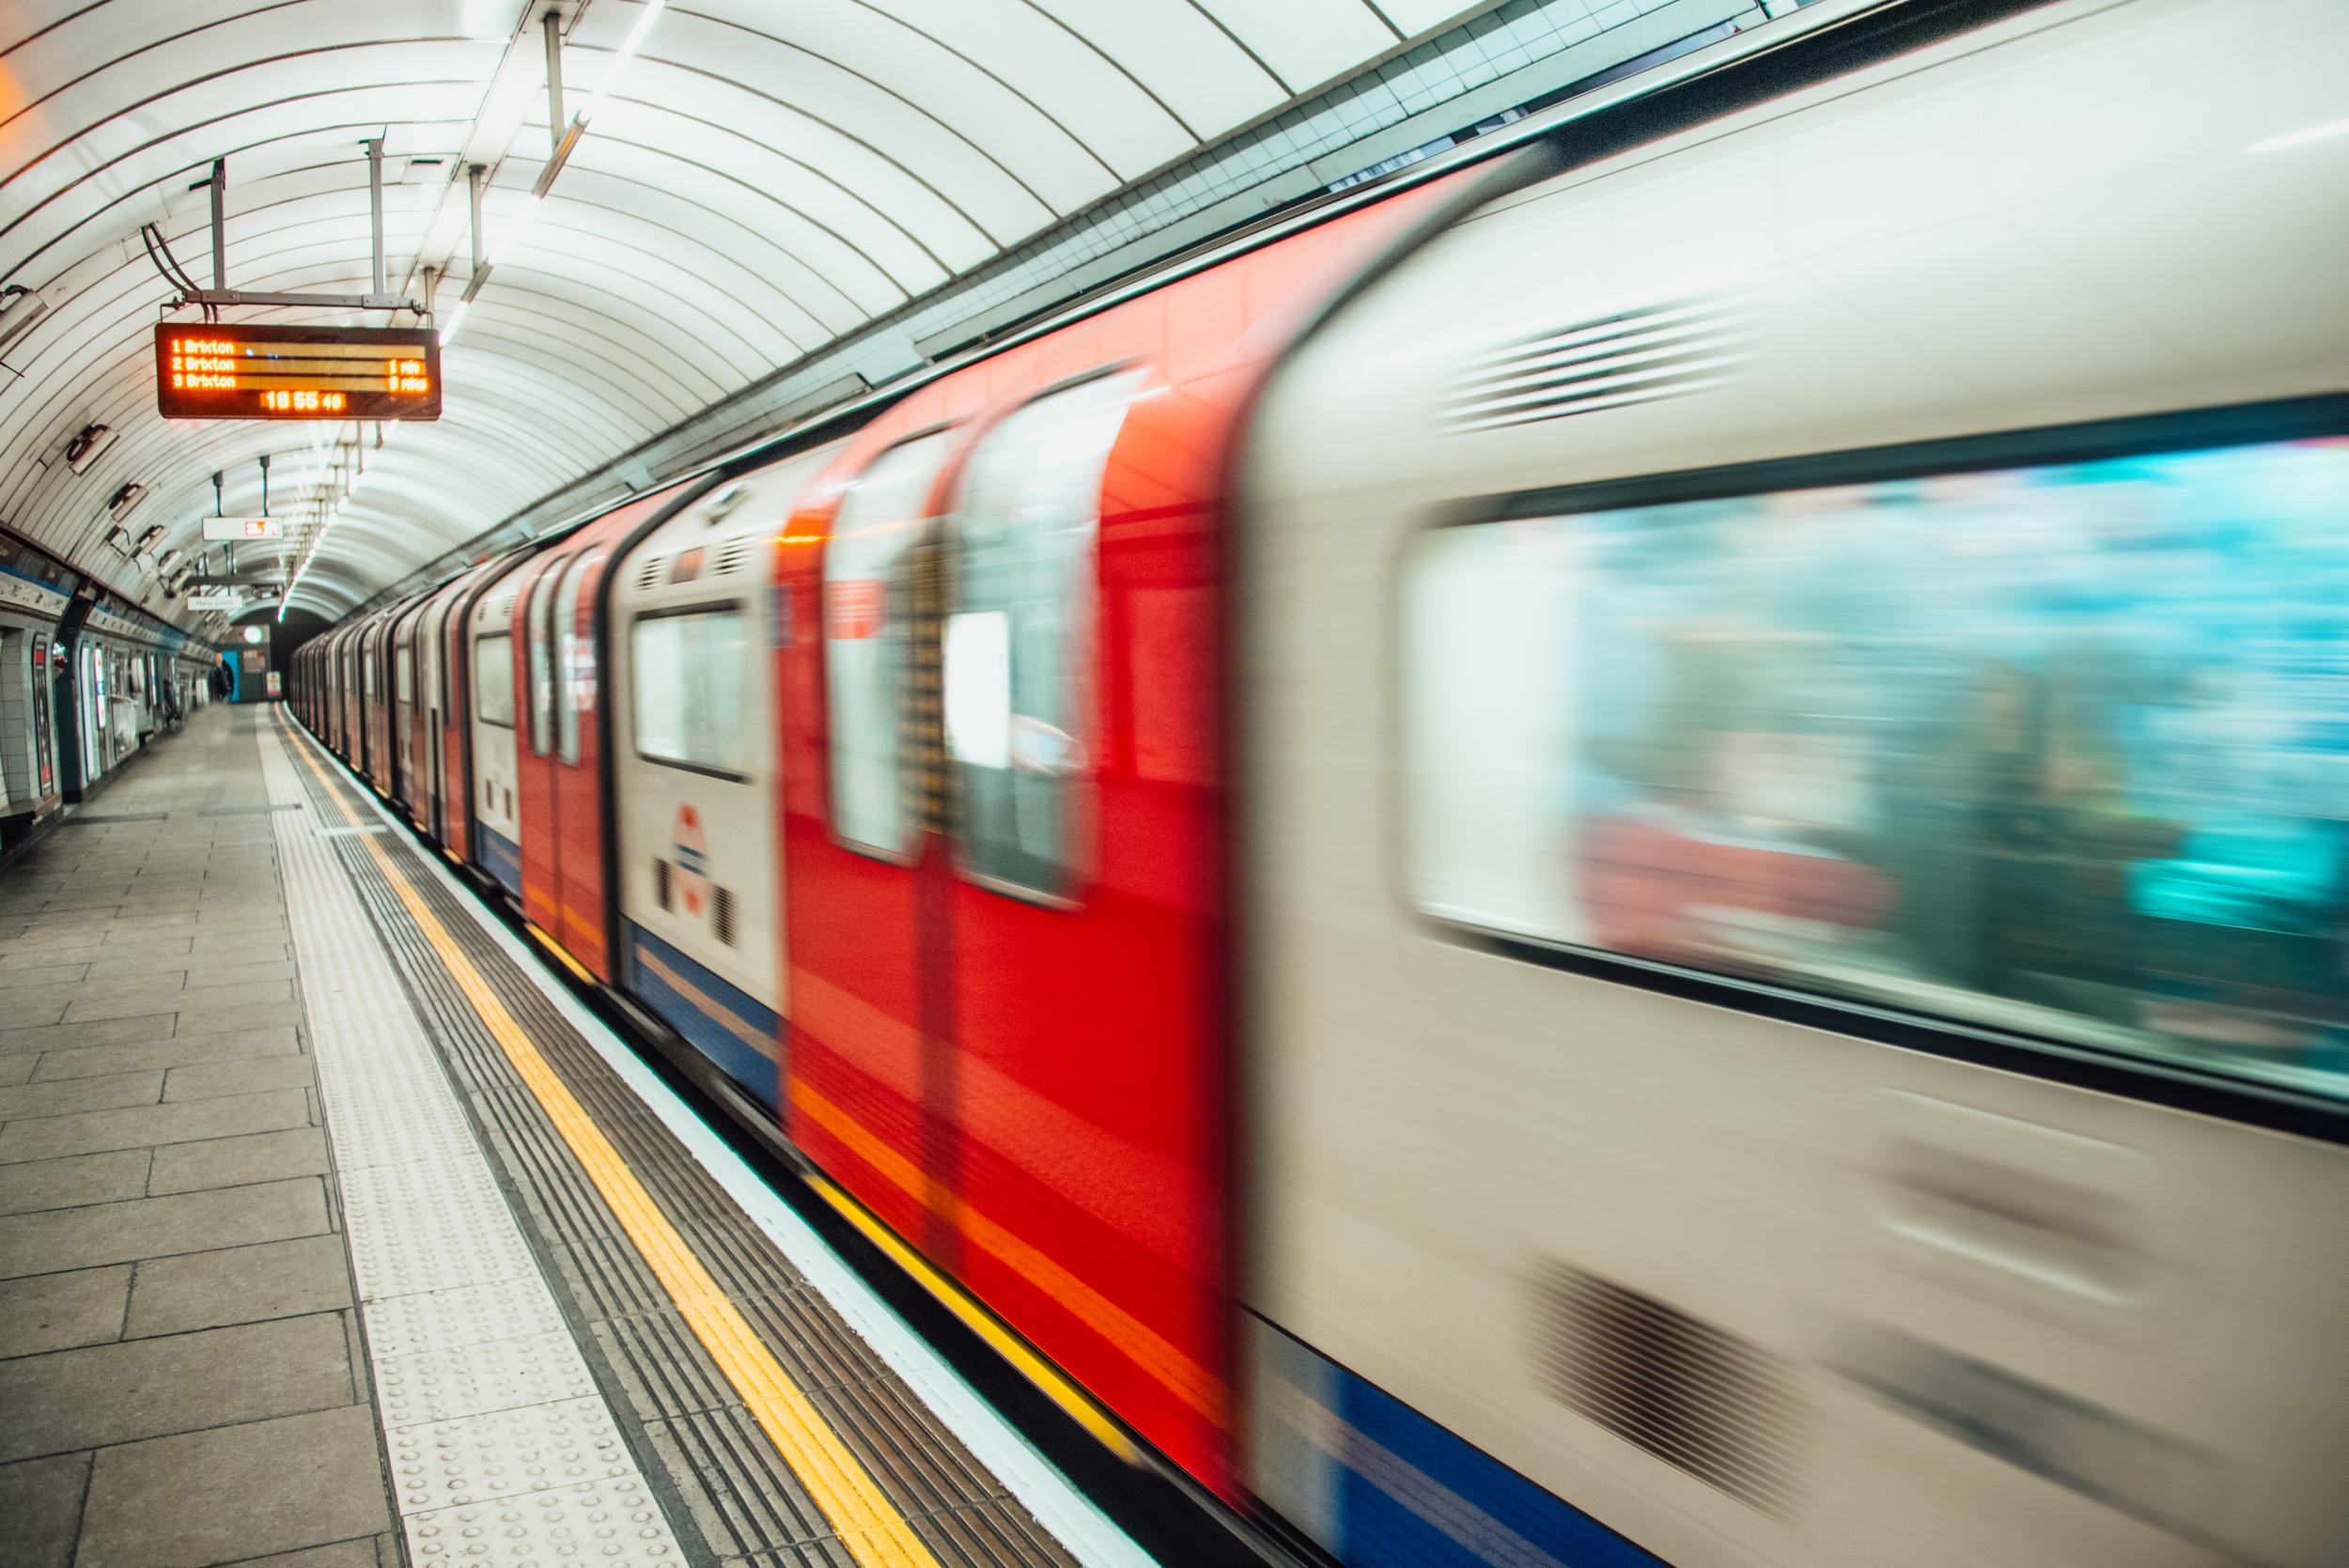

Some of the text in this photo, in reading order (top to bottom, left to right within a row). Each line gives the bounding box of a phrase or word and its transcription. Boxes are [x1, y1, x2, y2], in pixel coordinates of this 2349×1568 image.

[173, 339, 235, 354] 1 Brixton
[172, 357, 182, 371] 2
[185, 357, 236, 372] Brixton
[400, 360, 420, 375] min
[186, 374, 237, 388] Brixton
[401, 376, 428, 392] mins
